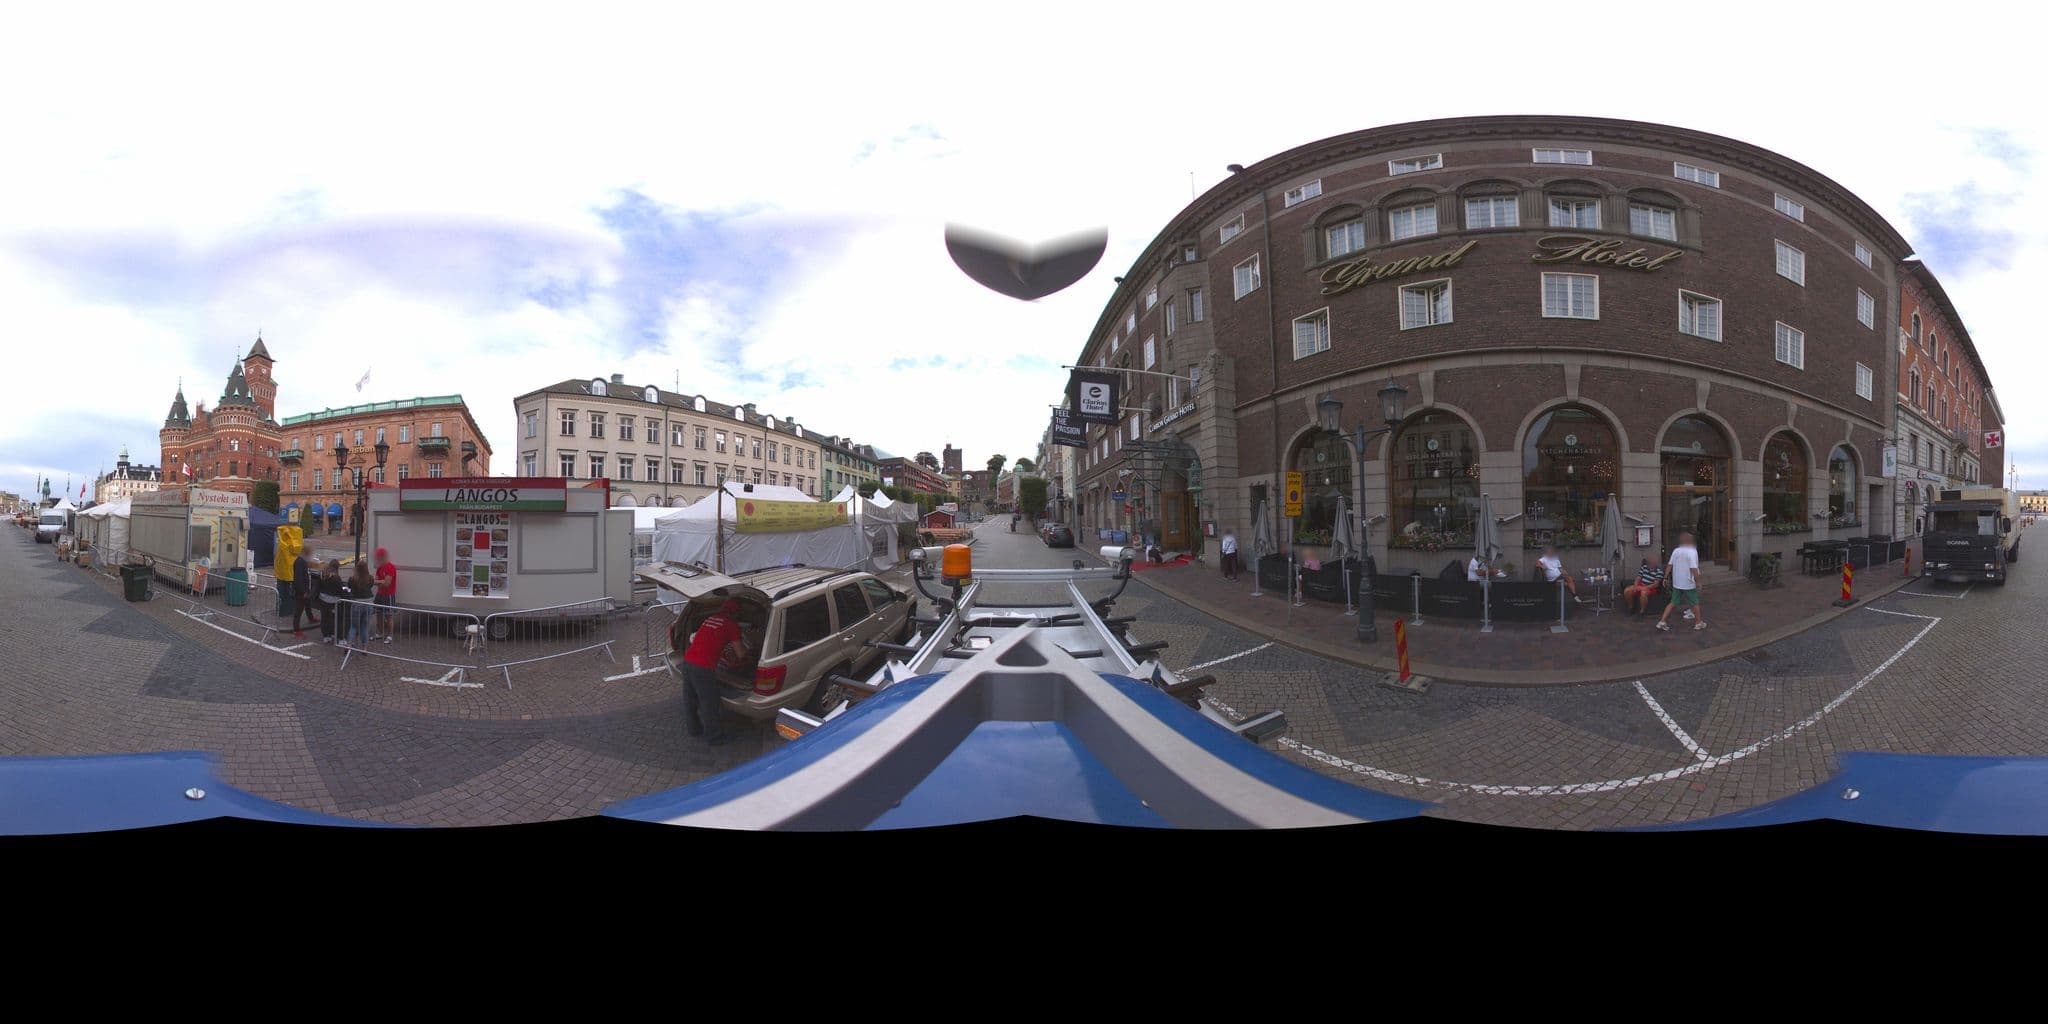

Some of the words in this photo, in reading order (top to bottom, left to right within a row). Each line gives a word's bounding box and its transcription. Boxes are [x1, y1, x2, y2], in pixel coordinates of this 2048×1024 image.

[1320, 240, 1478, 295] Grand
[1532, 236, 1684, 272] Hotel
[1179, 403, 1195, 416] HOTEL
[1055, 424, 1081, 435] PASSION
[231, 495, 244, 505] sill
